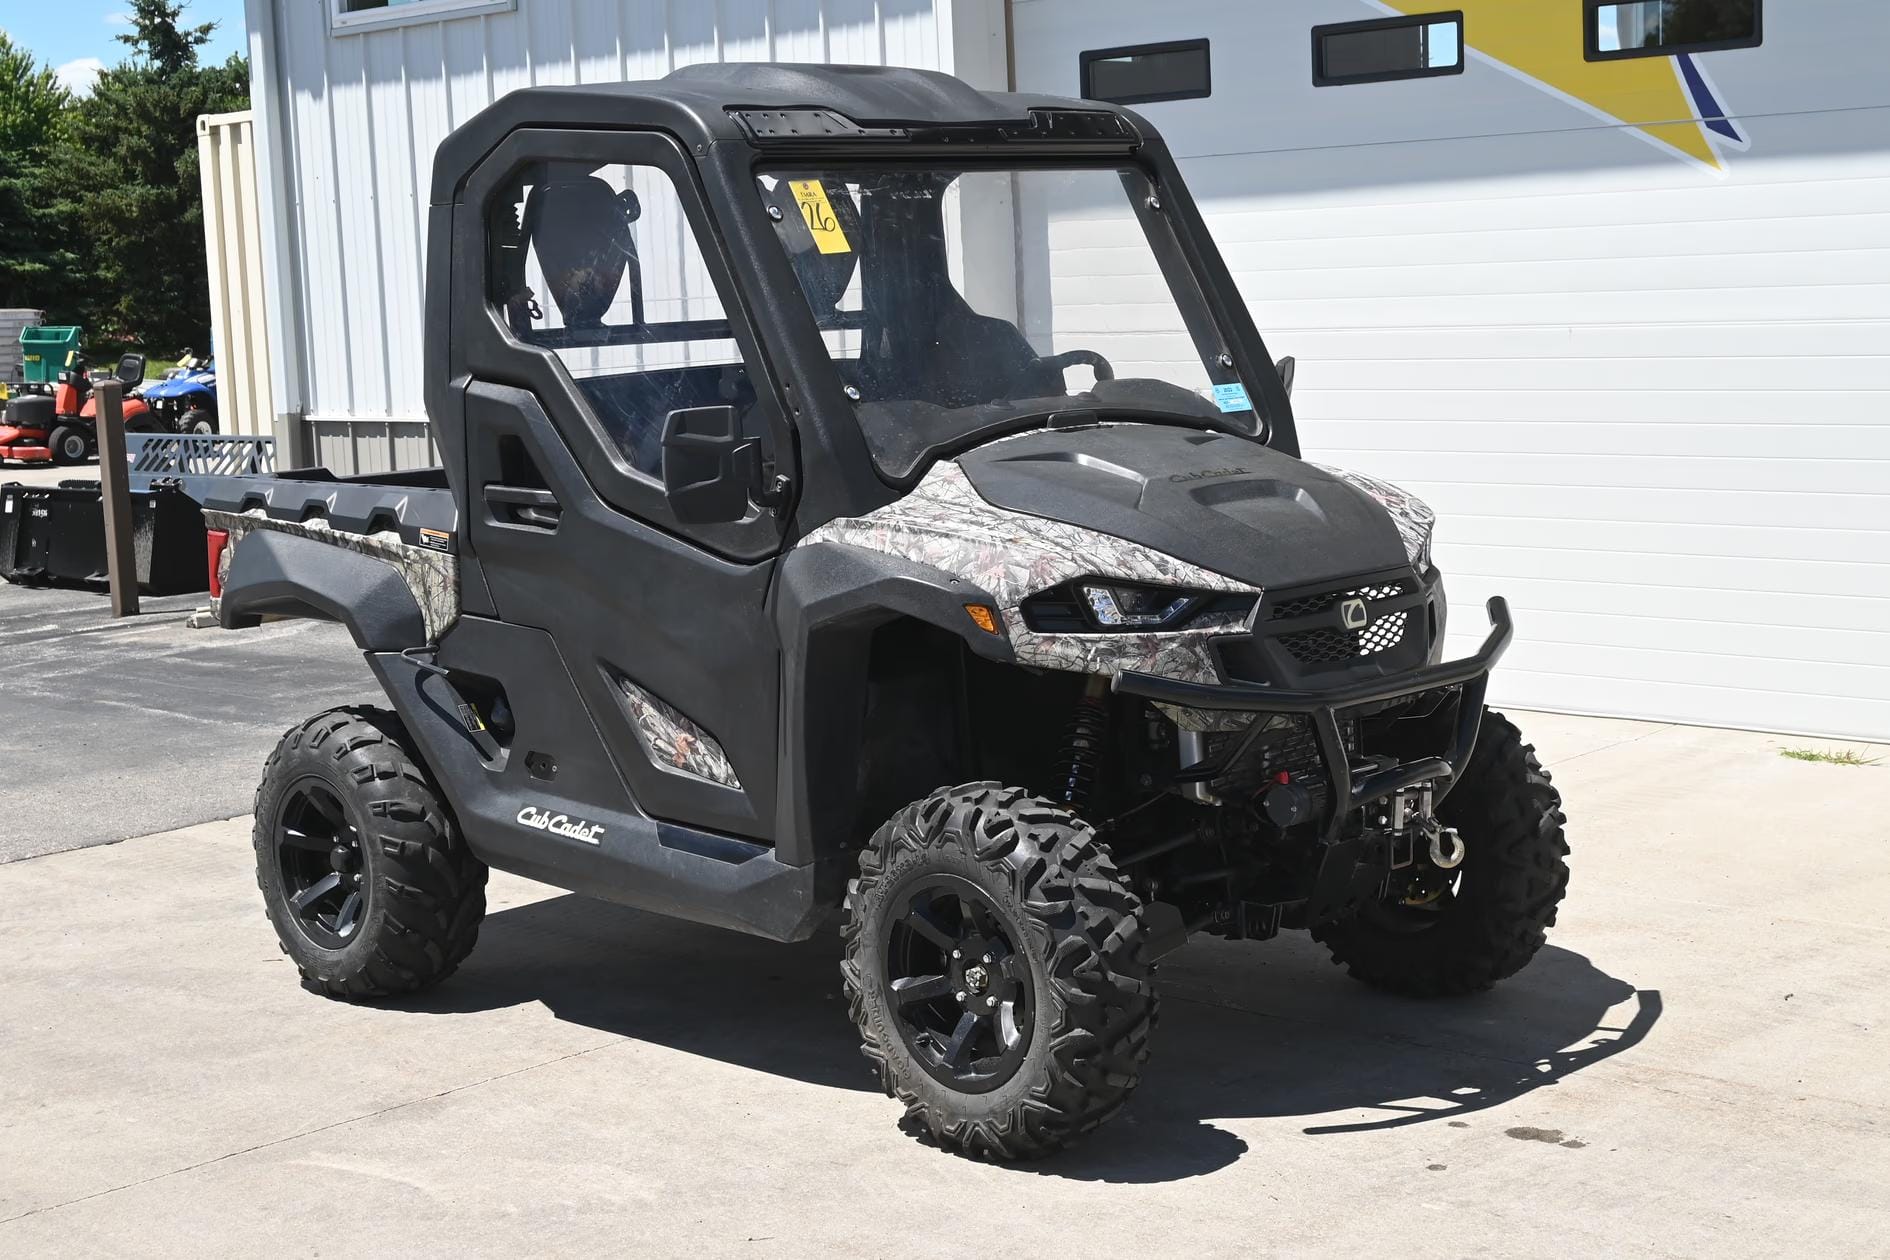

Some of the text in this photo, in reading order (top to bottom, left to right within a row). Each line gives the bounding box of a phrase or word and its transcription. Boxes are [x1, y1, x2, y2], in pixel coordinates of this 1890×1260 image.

[800, 201, 836, 233] 26
[516, 806, 605, 845] Cub Cadet
